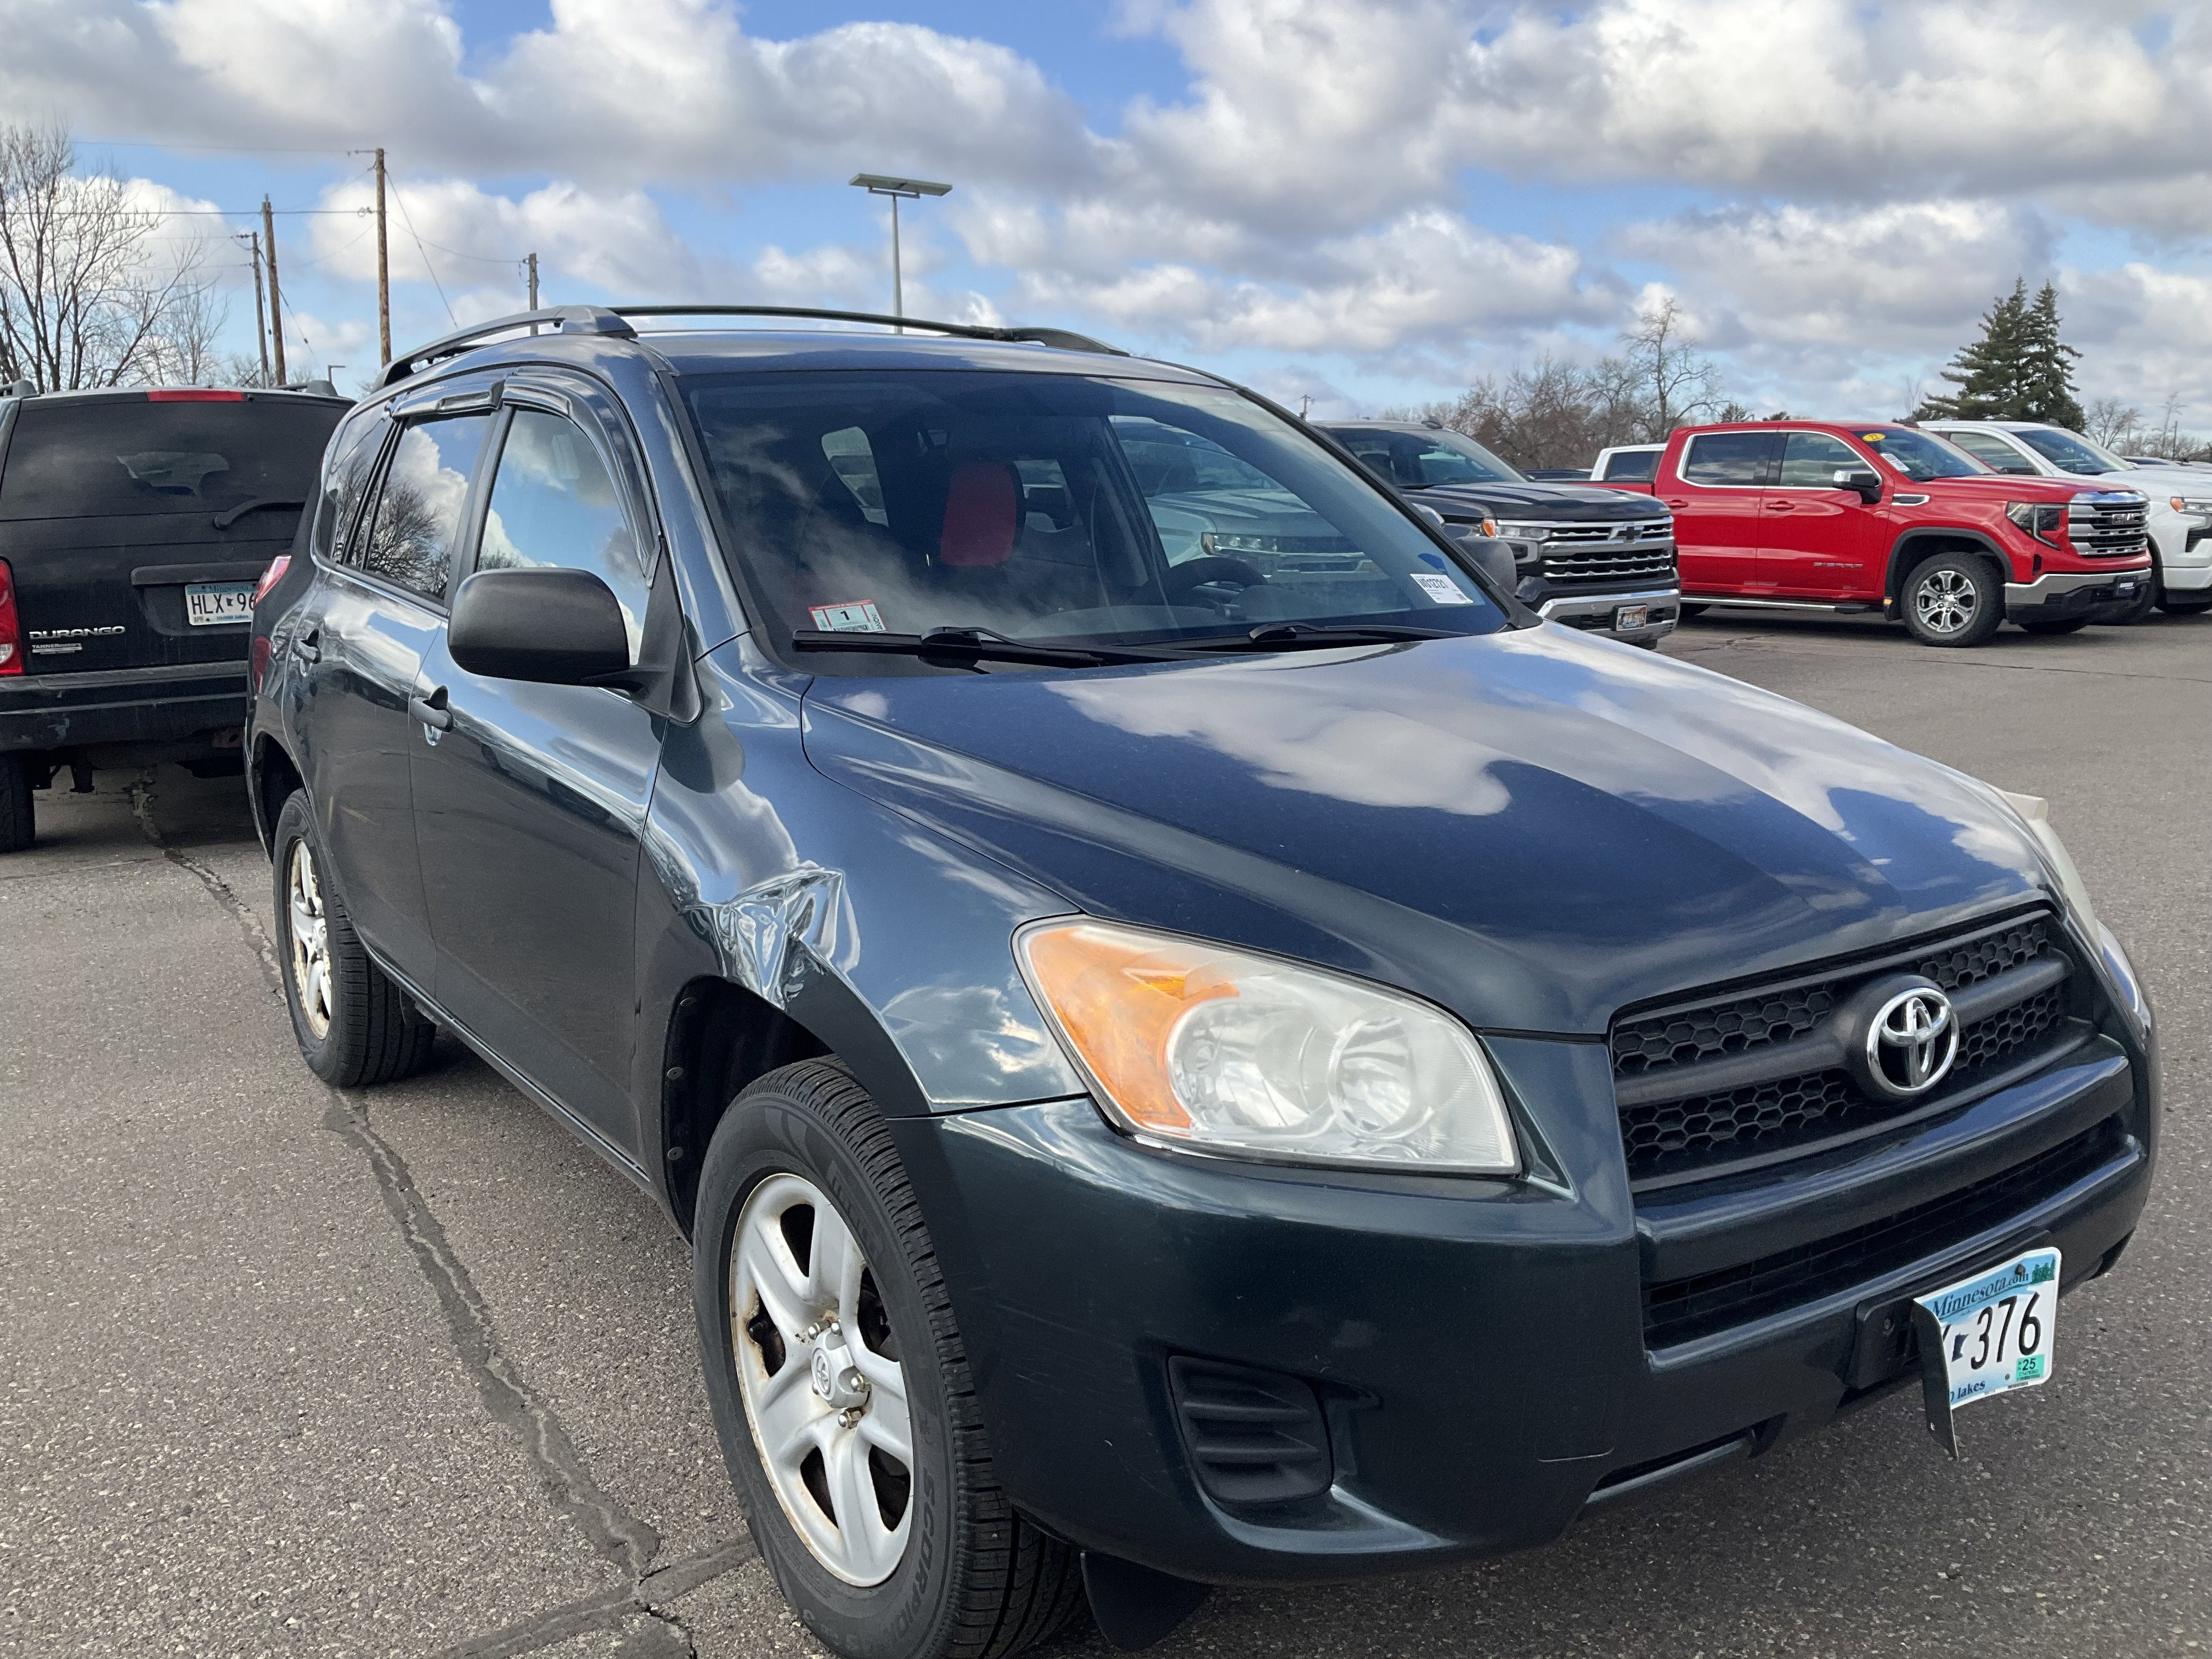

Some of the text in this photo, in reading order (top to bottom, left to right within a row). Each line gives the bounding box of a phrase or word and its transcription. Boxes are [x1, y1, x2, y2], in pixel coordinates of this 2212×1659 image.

[191, 594, 224, 614] HLX
[840, 610, 850, 620] 1
[29, 625, 126, 639] DURANGO
[1933, 1273, 2029, 1317] Minnesota.com
[1970, 1291, 2041, 1370] 376
[2022, 1358, 2036, 1370] 25
[1958, 1380, 1985, 1398] lakes
